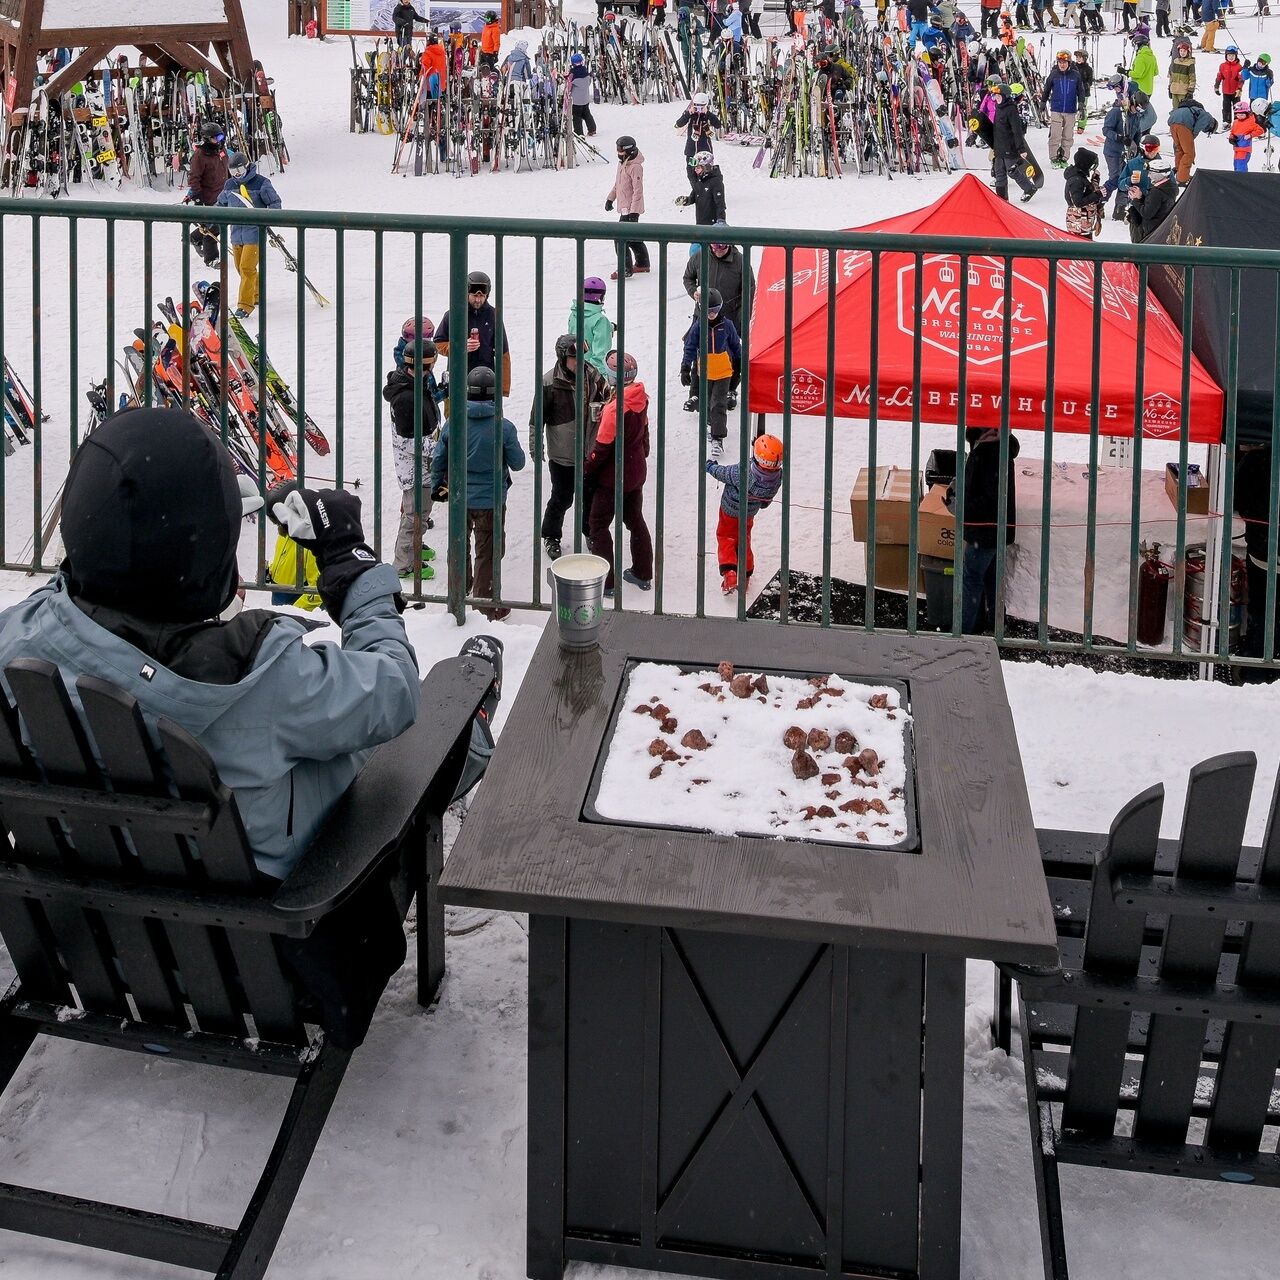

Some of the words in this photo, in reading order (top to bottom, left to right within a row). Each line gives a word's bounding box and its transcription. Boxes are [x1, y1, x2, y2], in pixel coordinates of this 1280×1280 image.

[912, 287, 1038, 323] No-Li
[921, 319, 1033, 336] BREHOUSE
[842, 384, 913, 407] No-Li
[316, 498, 331, 529] HESTRA
